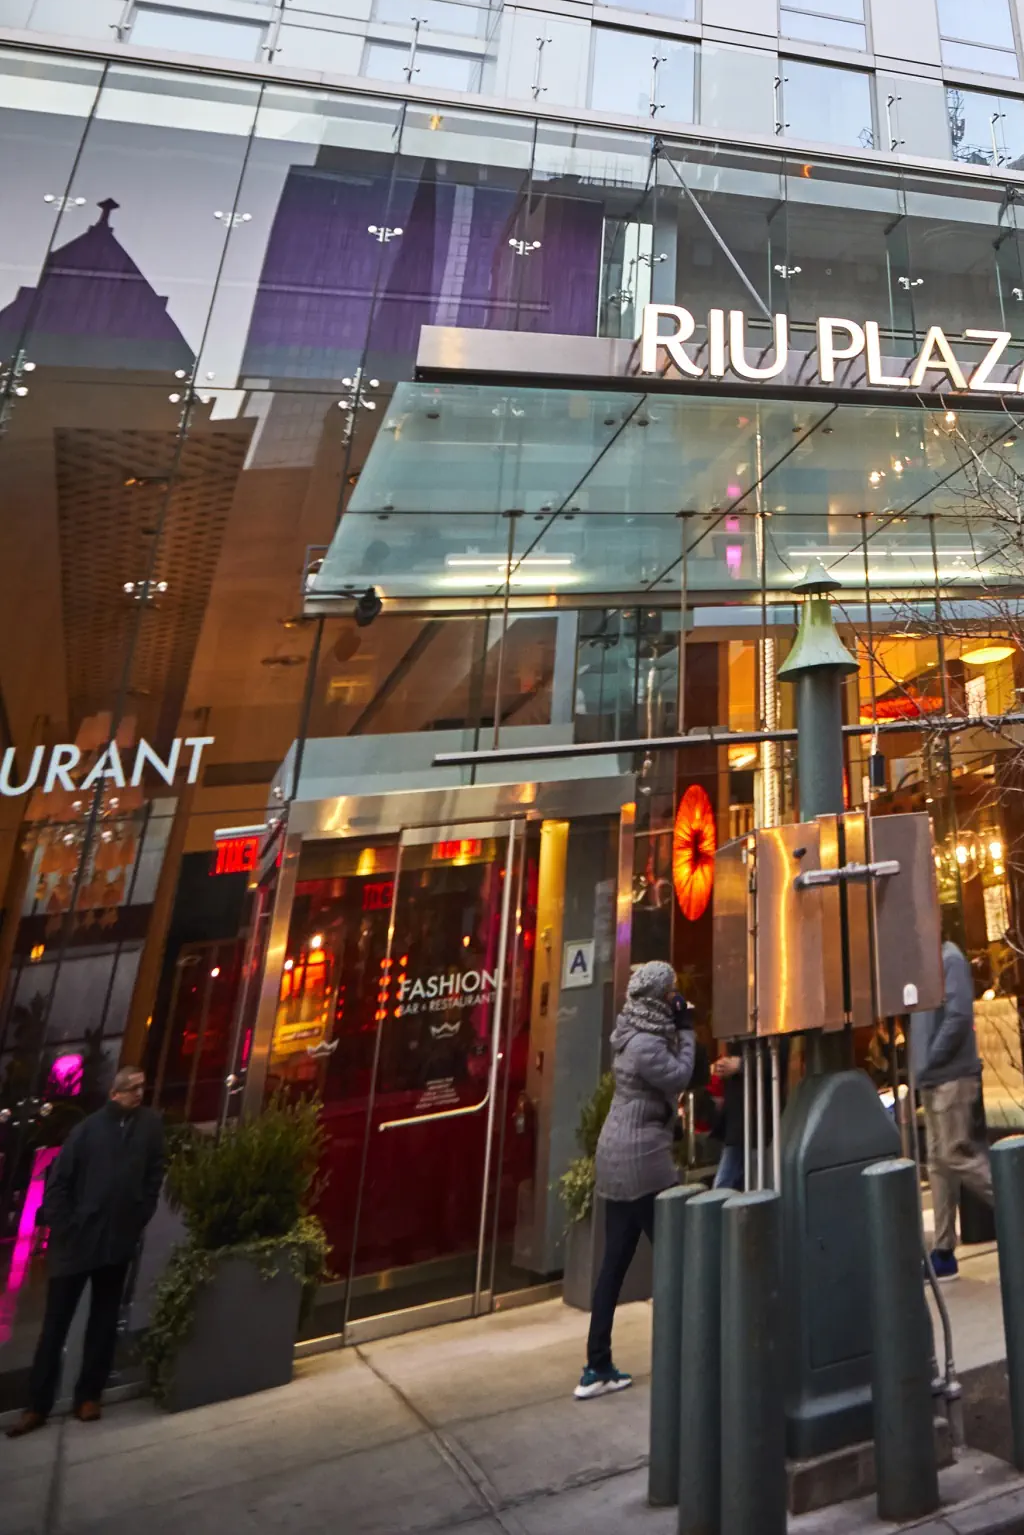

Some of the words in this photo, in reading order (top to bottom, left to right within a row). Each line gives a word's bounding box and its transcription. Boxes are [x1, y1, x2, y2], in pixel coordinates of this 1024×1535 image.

[641, 303, 789, 380] RIU
[0, 737, 215, 797] URANT
[399, 967, 500, 1002] FASHION
[569, 949, 588, 975] A
